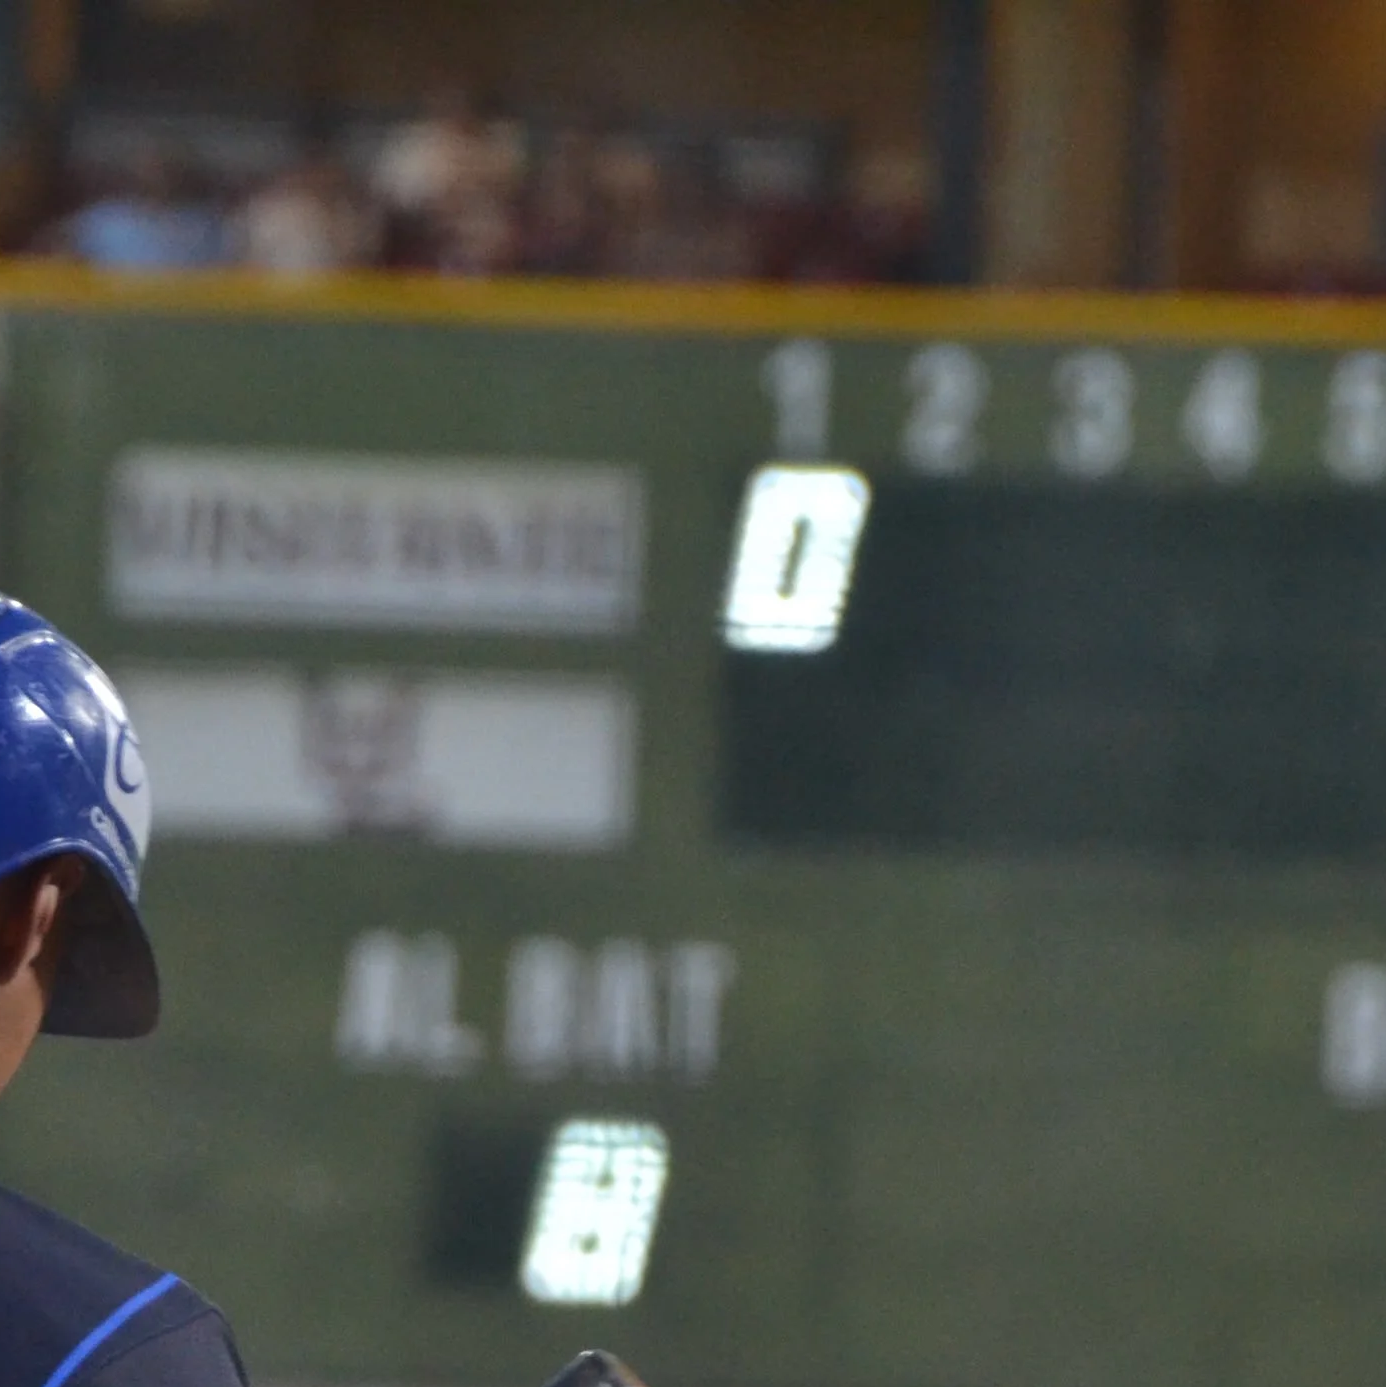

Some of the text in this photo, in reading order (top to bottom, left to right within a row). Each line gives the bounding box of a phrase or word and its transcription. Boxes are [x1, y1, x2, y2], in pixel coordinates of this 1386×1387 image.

[763, 338, 831, 458] 1
[905, 341, 987, 475] 2
[1051, 348, 1135, 480] 3
[723, 464, 871, 652] 0
[335, 928, 735, 1085] AL BAT
